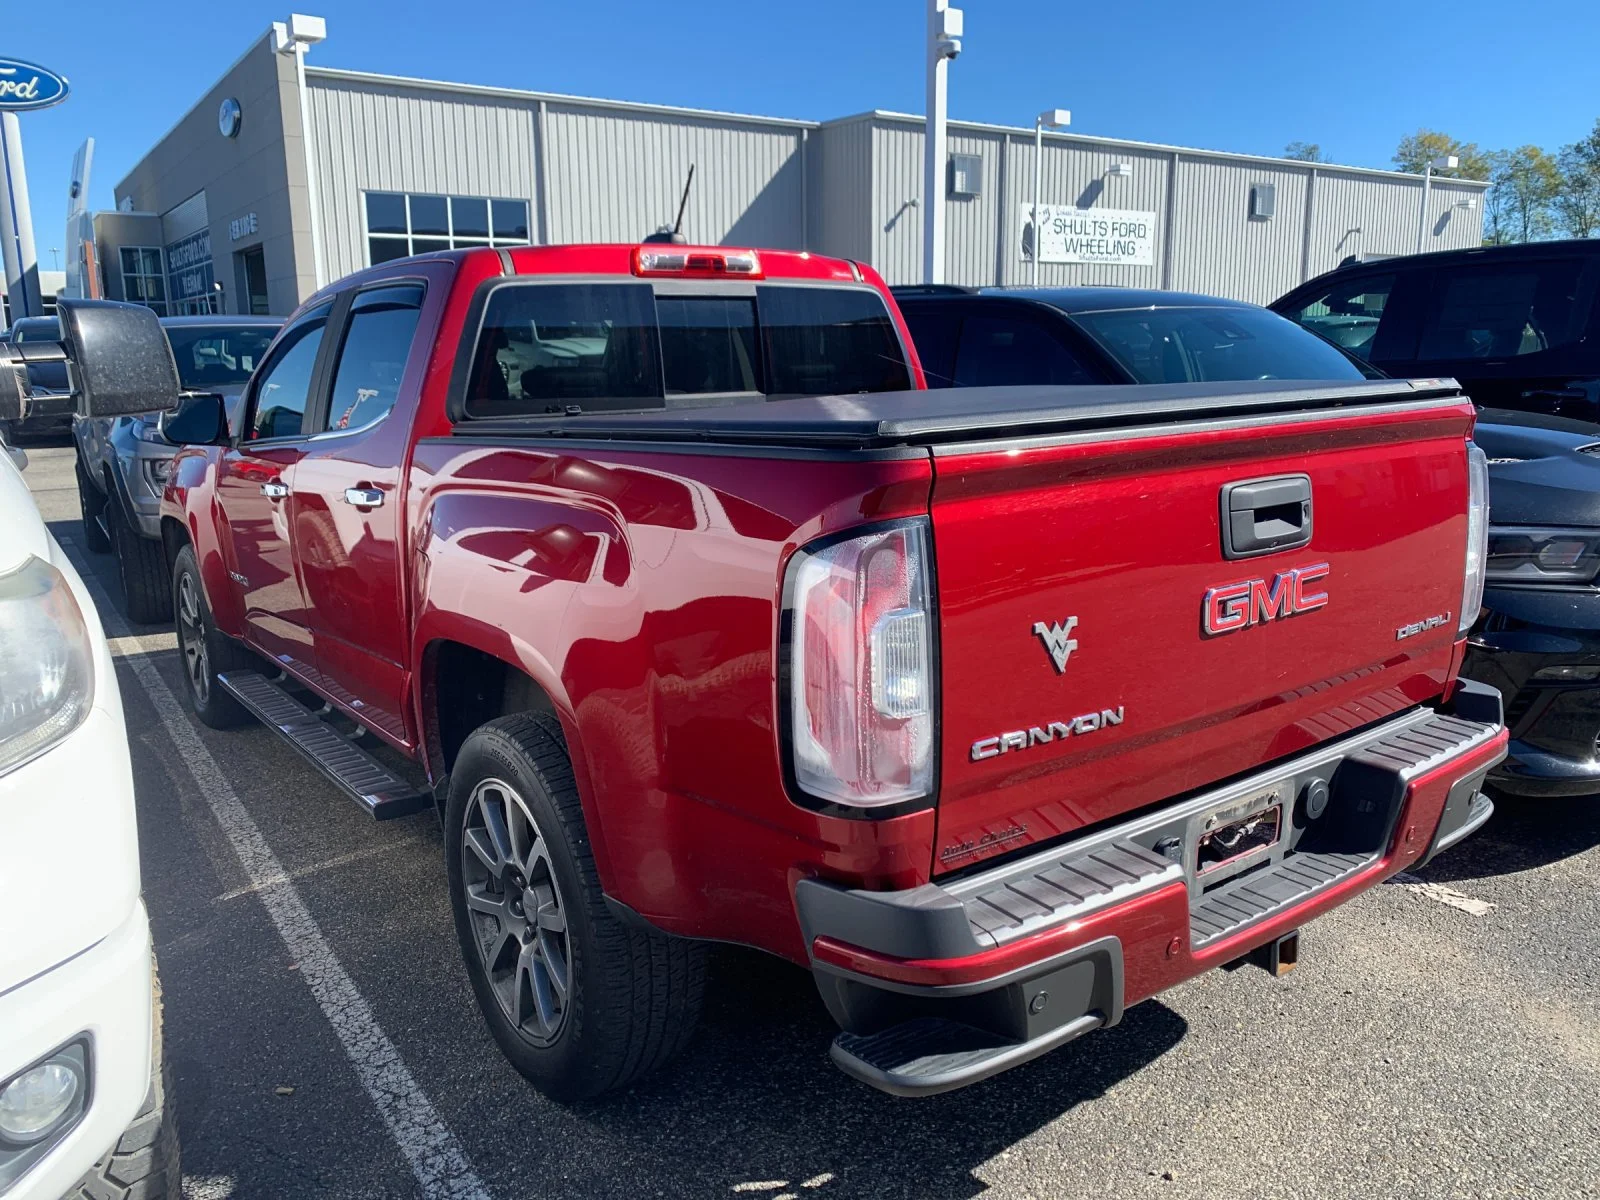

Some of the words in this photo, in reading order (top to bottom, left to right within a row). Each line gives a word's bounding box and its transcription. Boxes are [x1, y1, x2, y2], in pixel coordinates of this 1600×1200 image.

[1054, 218, 1109, 237] SHULTS
[1111, 221, 1147, 238] FORD
[1064, 237, 1136, 256] WHEELING
[1203, 562, 1330, 635] GMC
[1396, 611, 1452, 641] DENALI
[970, 706, 1125, 761] CANYON
